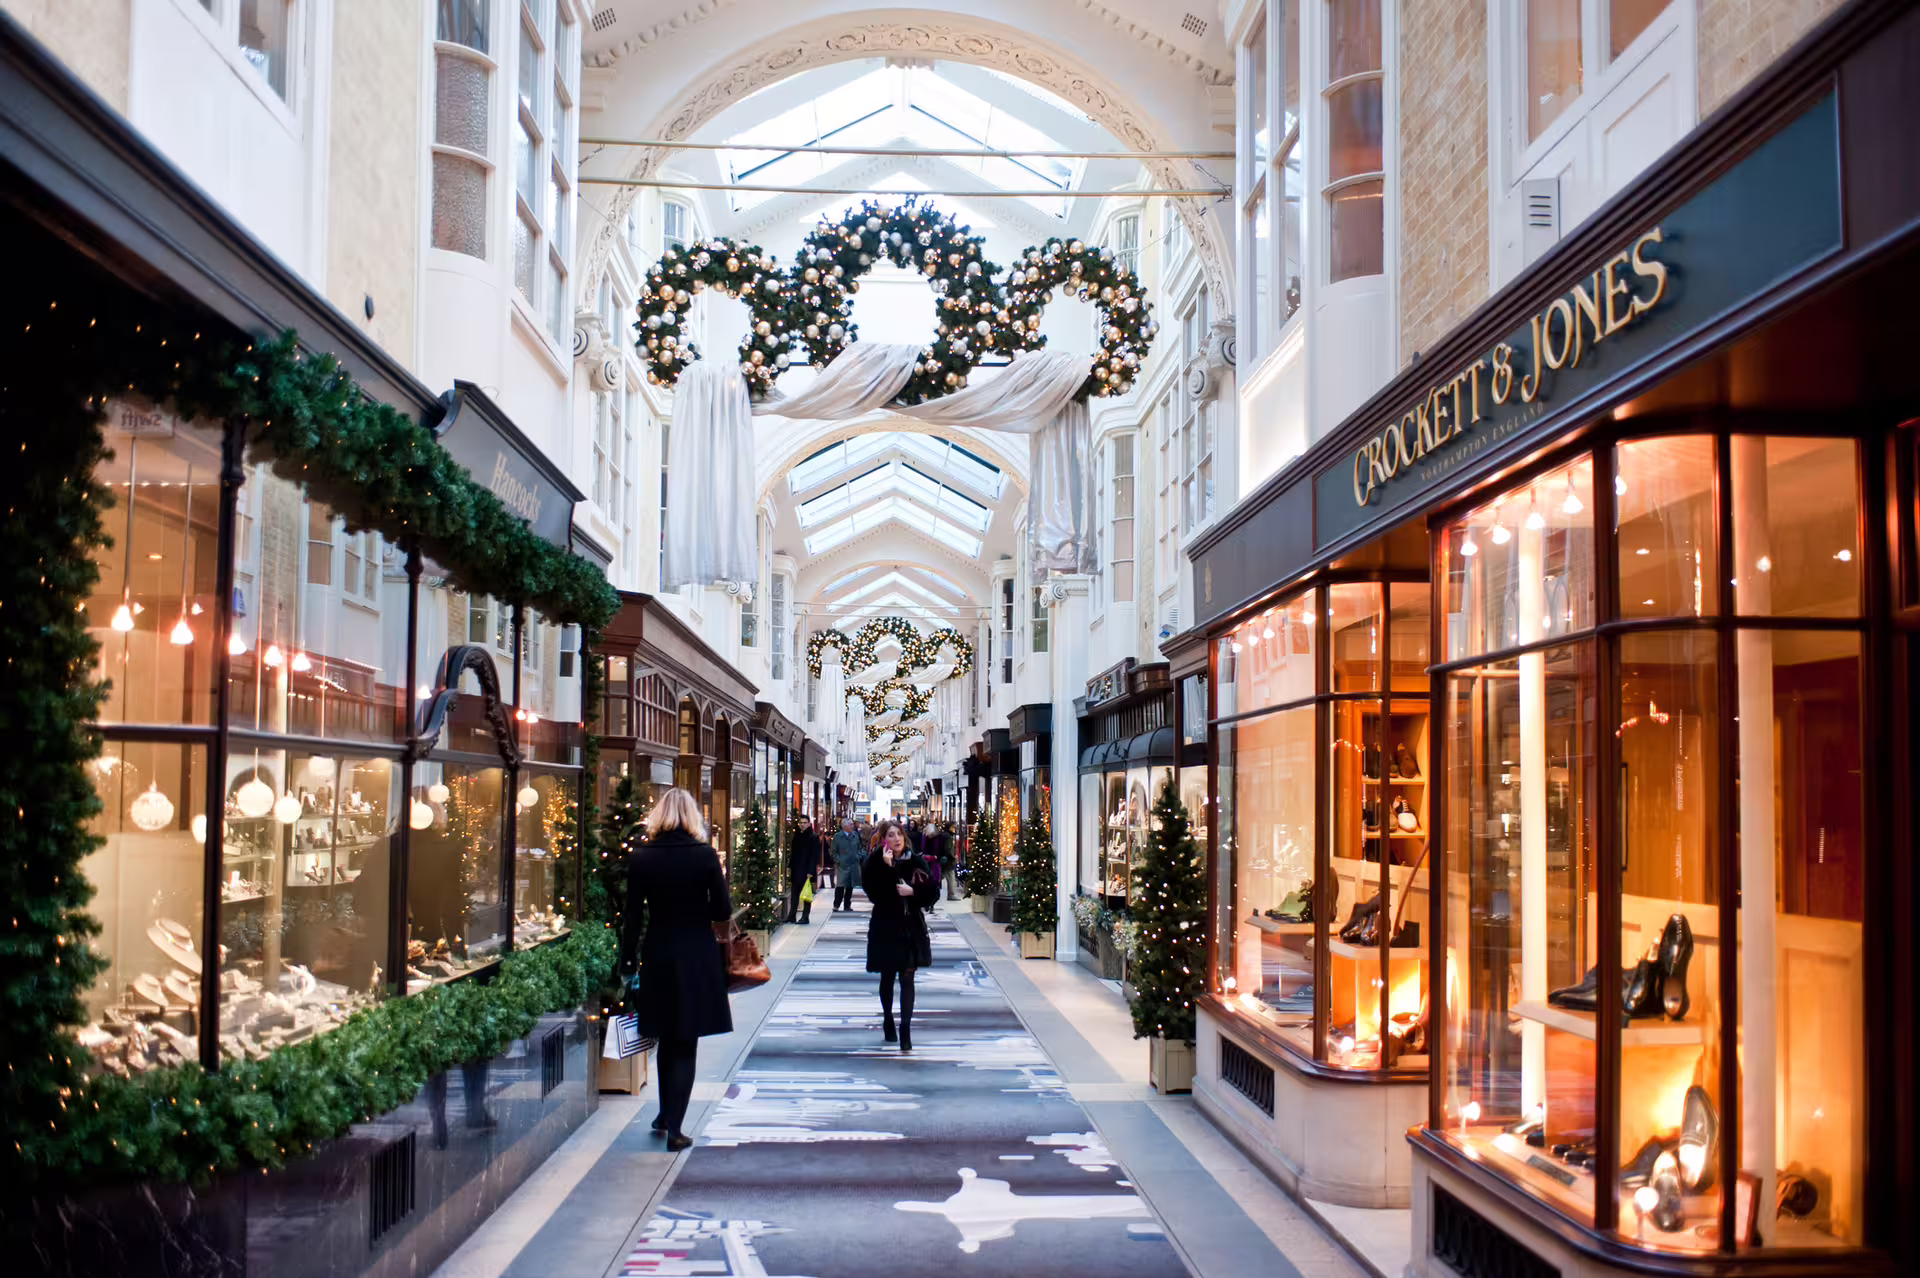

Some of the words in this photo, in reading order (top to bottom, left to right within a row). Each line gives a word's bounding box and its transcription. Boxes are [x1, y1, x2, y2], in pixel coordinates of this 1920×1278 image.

[1353, 358, 1486, 507] CROCKETT
[1491, 342, 1513, 405] &
[1520, 227, 1668, 404] JONES
[1421, 435, 1489, 481] NORTHAMPTON
[1492, 401, 1544, 440] ENGLAND
